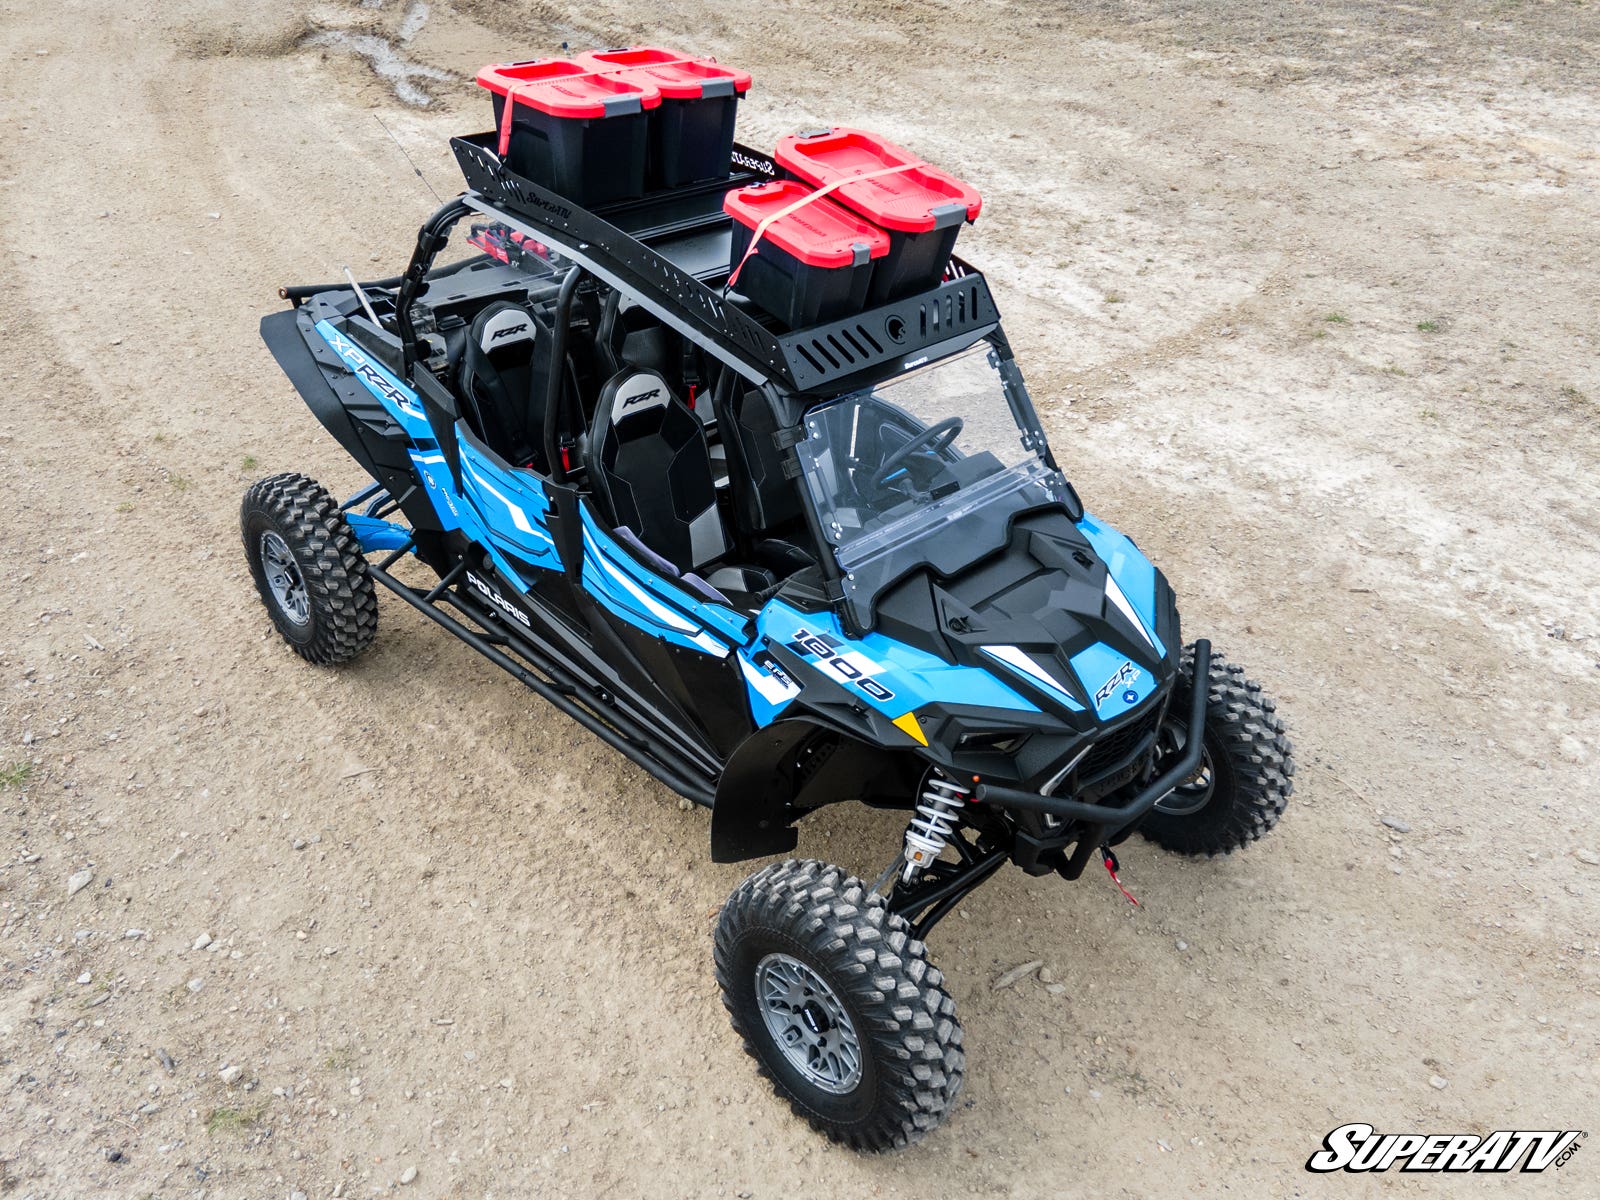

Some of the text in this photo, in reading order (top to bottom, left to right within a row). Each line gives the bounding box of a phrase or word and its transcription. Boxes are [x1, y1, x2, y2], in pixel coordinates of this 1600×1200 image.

[490, 323, 528, 341] RZR
[328, 334, 411, 410] XP RZR
[622, 388, 661, 410] RZR
[465, 570, 531, 627] POLARIS
[791, 627, 896, 702] 1000
[1094, 660, 1133, 711] RZR
